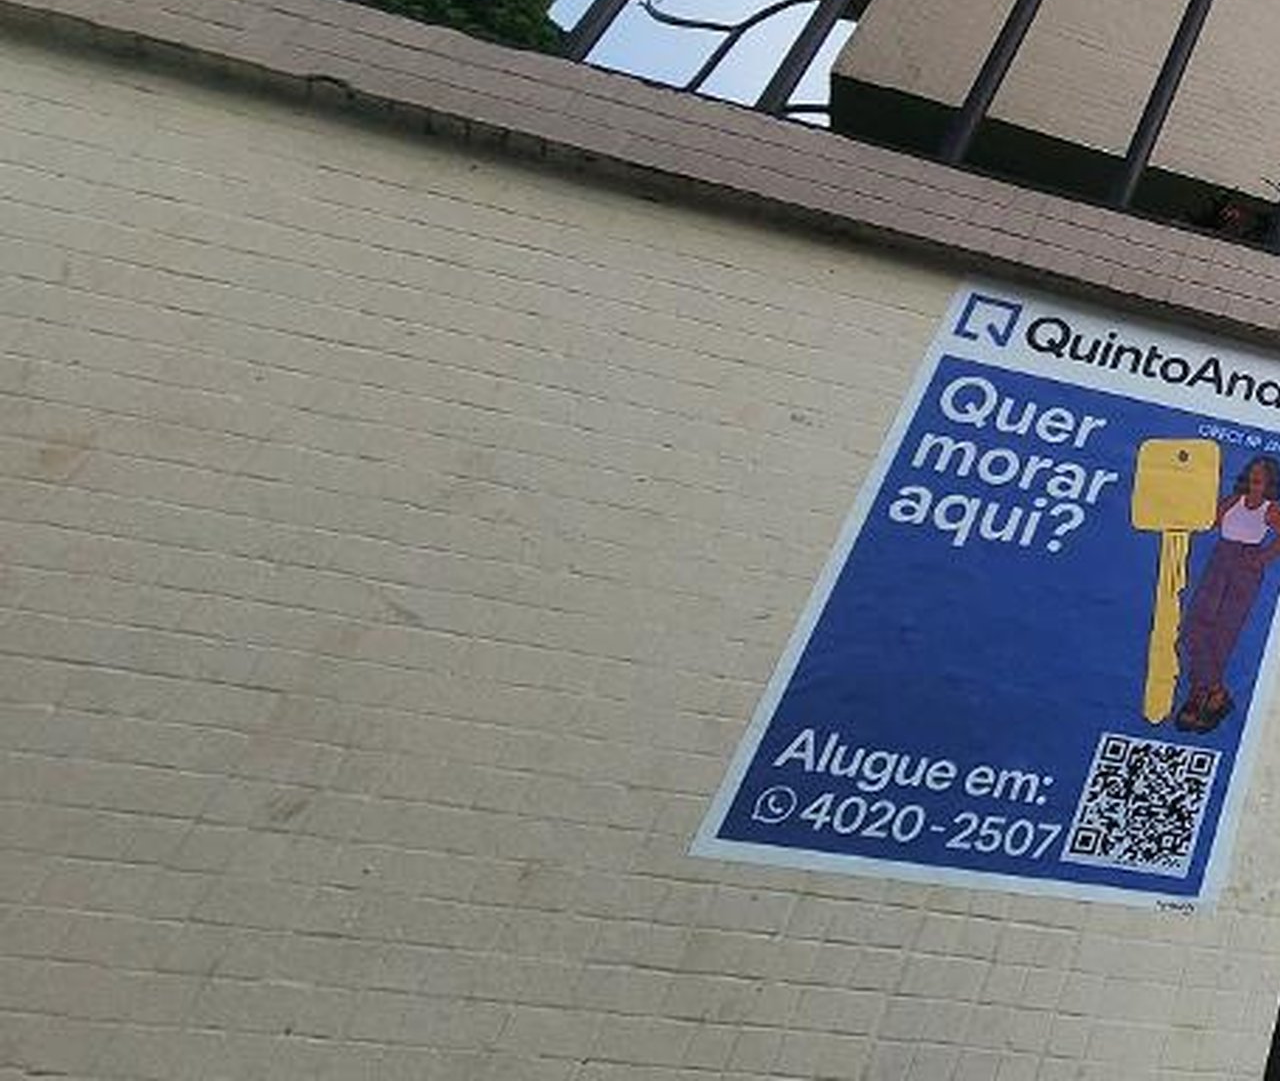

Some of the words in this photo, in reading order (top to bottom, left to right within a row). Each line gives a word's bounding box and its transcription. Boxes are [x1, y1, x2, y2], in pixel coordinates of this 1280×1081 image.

[940, 376, 1107, 448] Quer
[911, 429, 1119, 503] morar
[888, 482, 1085, 553] aqui?
[774, 727, 954, 792] Alugue
[964, 765, 1055, 804] em:
[799, 791, 1062, 860] 4020-2507
